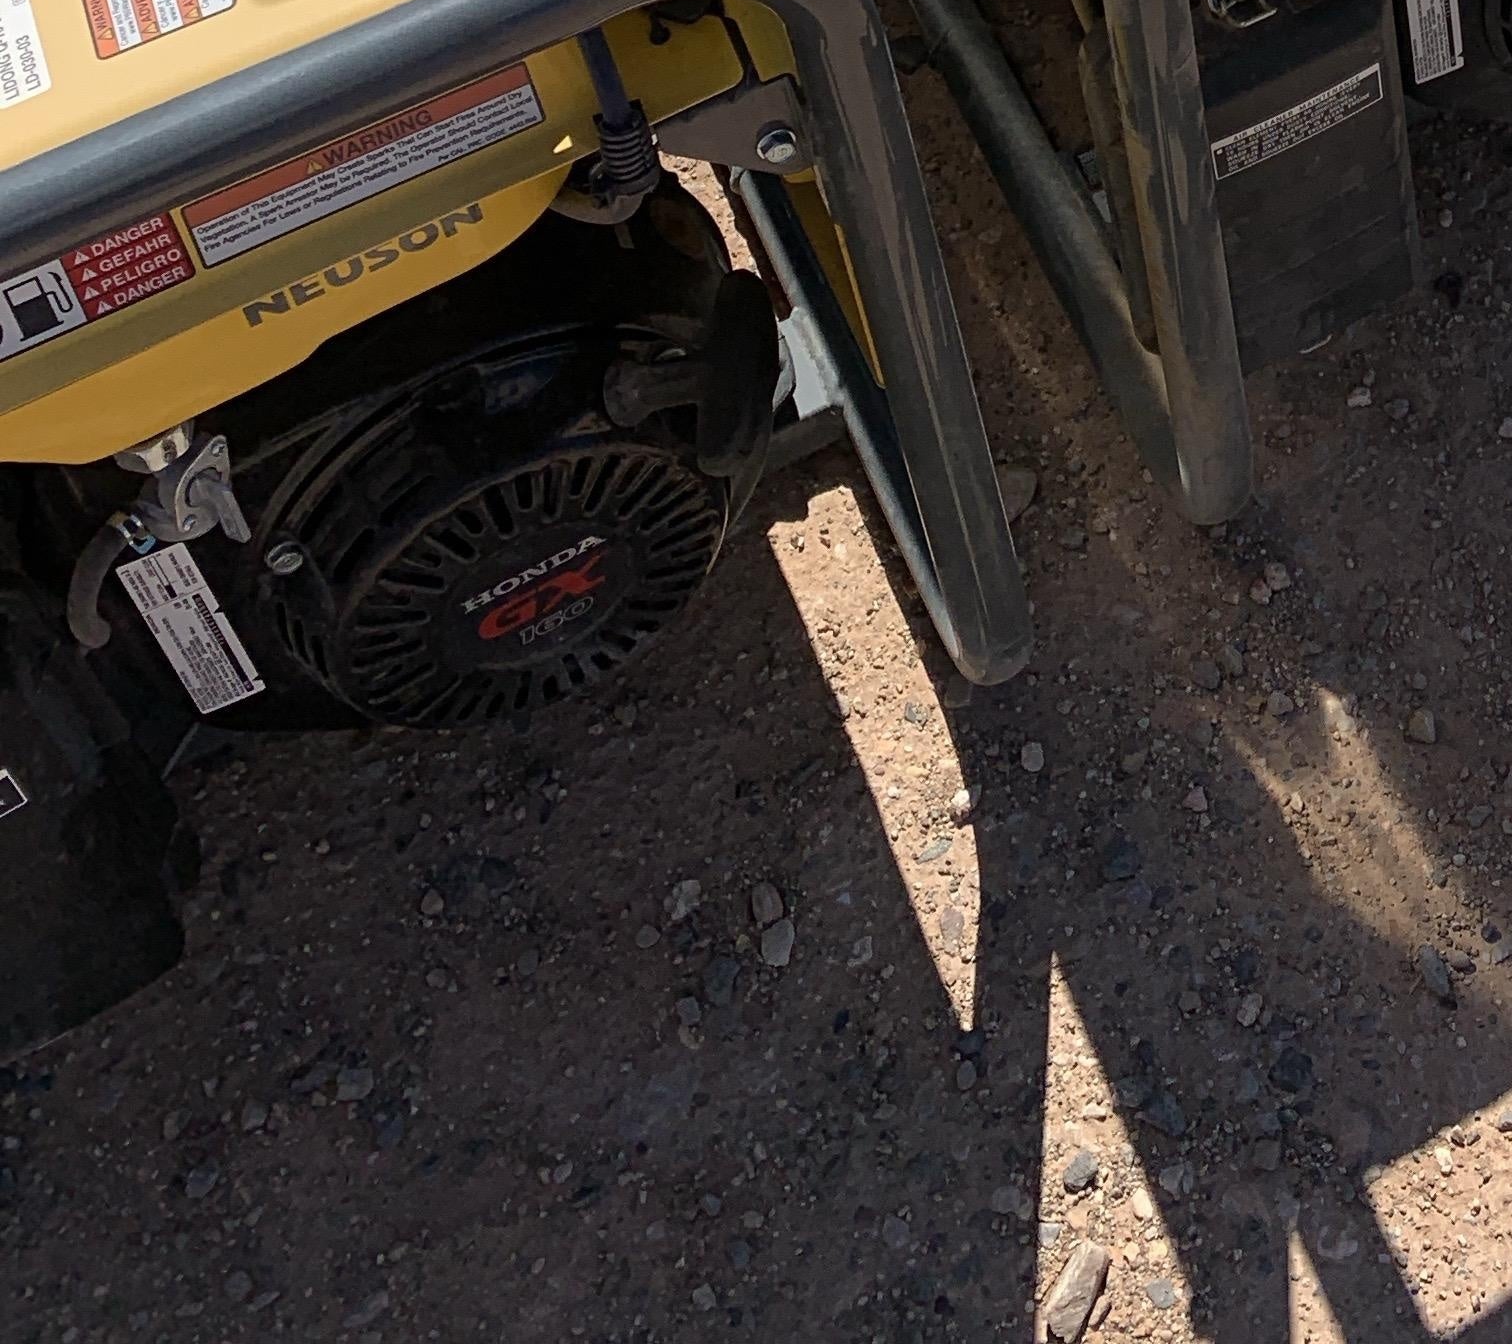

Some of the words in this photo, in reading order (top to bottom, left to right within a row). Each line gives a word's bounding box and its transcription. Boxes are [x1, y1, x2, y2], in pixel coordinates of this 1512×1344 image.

[16, 34, 42, 91] LD-030-03
[1233, 131, 1247, 141] AIR
[1253, 111, 1294, 132] CLEANER
[1300, 75, 1360, 110] MAINTENANCE
[196, 212, 239, 236] Operation
[239, 206, 251, 217] of
[251, 198, 270, 212] This
[270, 178, 317, 204] Equipment
[317, 170, 336, 184] May
[336, 157, 365, 175] Create
[365, 144, 395, 163] Sparks
[396, 135, 415, 149] That
[416, 127, 433, 141] Can
[434, 118, 454, 133] Start
[455, 109, 475, 124] Fires
[476, 96, 506, 115] Around
[507, 89, 522, 101] Dry
[323, 108, 433, 167] WARNING
[91, 217, 165, 257] DANGER
[99, 234, 172, 272] GEFAHR
[242, 203, 484, 327] NEUSON
[101, 248, 182, 291] PELIGRO
[113, 267, 187, 306] DANGER
[461, 536, 608, 614] HONDA
[478, 552, 605, 640] GX
[520, 596, 595, 645] 160
